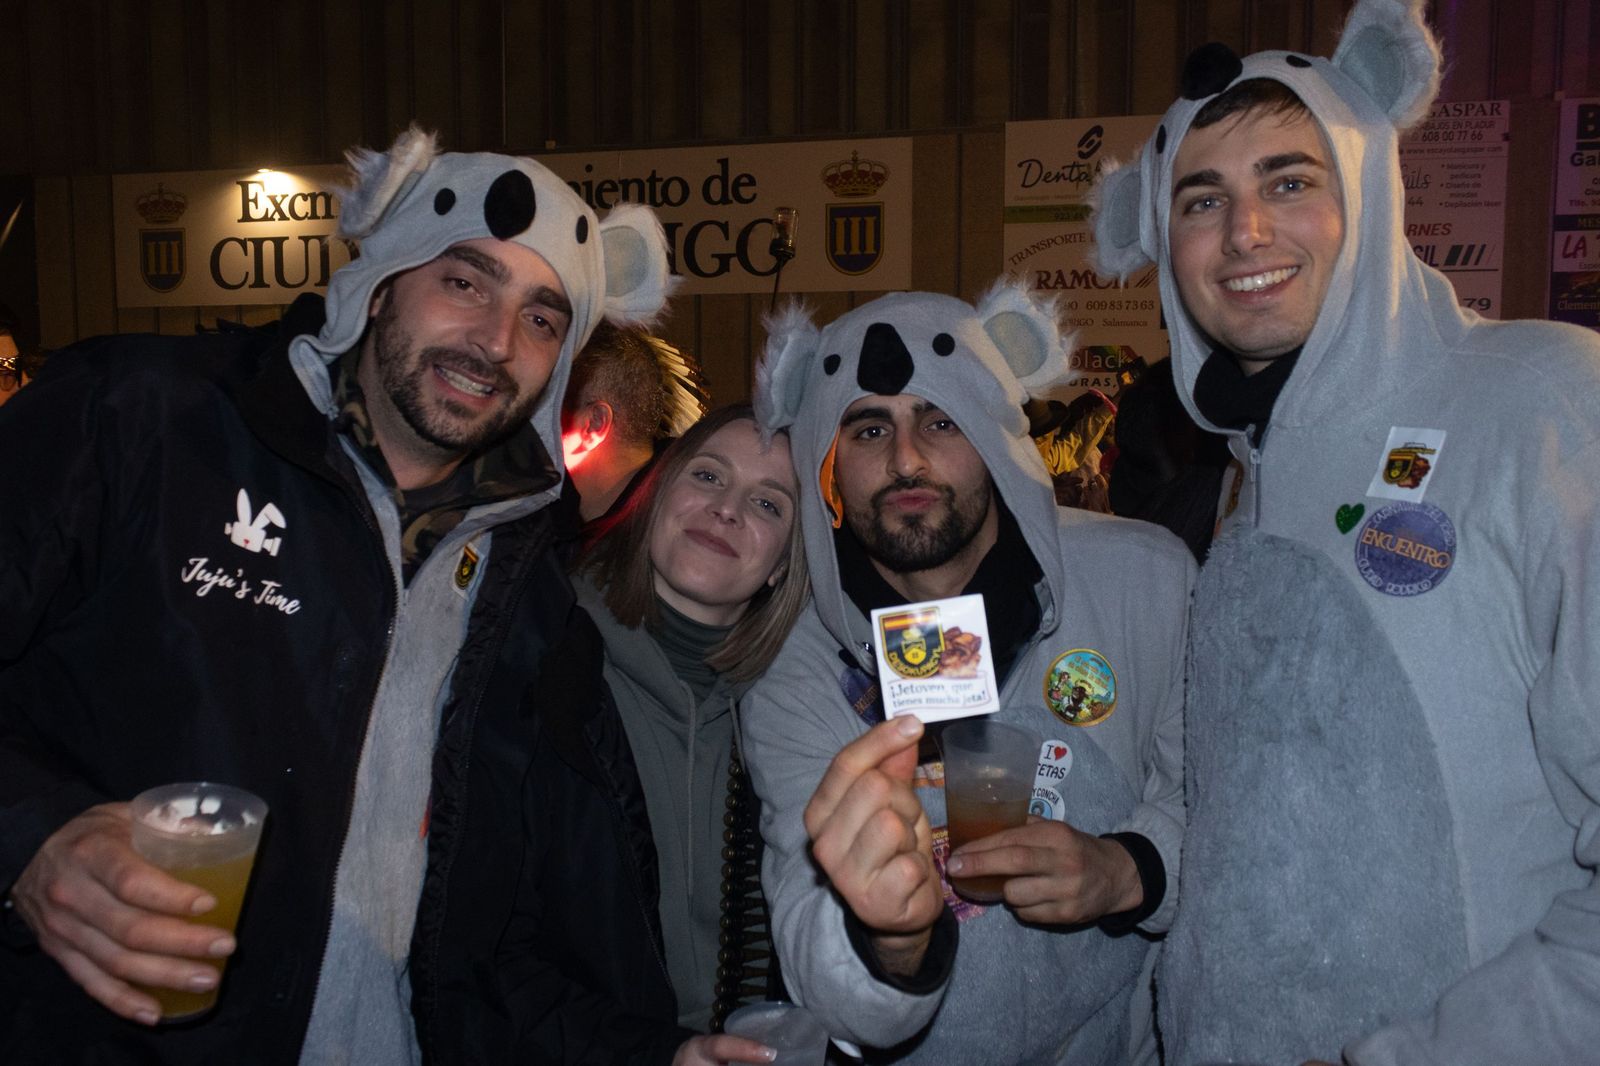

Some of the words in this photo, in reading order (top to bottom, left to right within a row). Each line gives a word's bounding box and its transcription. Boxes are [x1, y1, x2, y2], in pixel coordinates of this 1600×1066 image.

[701, 158, 757, 205] de
[1562, 234, 1587, 259] LA
[1361, 528, 1450, 569] ENCUENTRO
[253, 579, 301, 615] Time
[1044, 744, 1054, 760] I
[1037, 763, 1066, 779] ETAS
